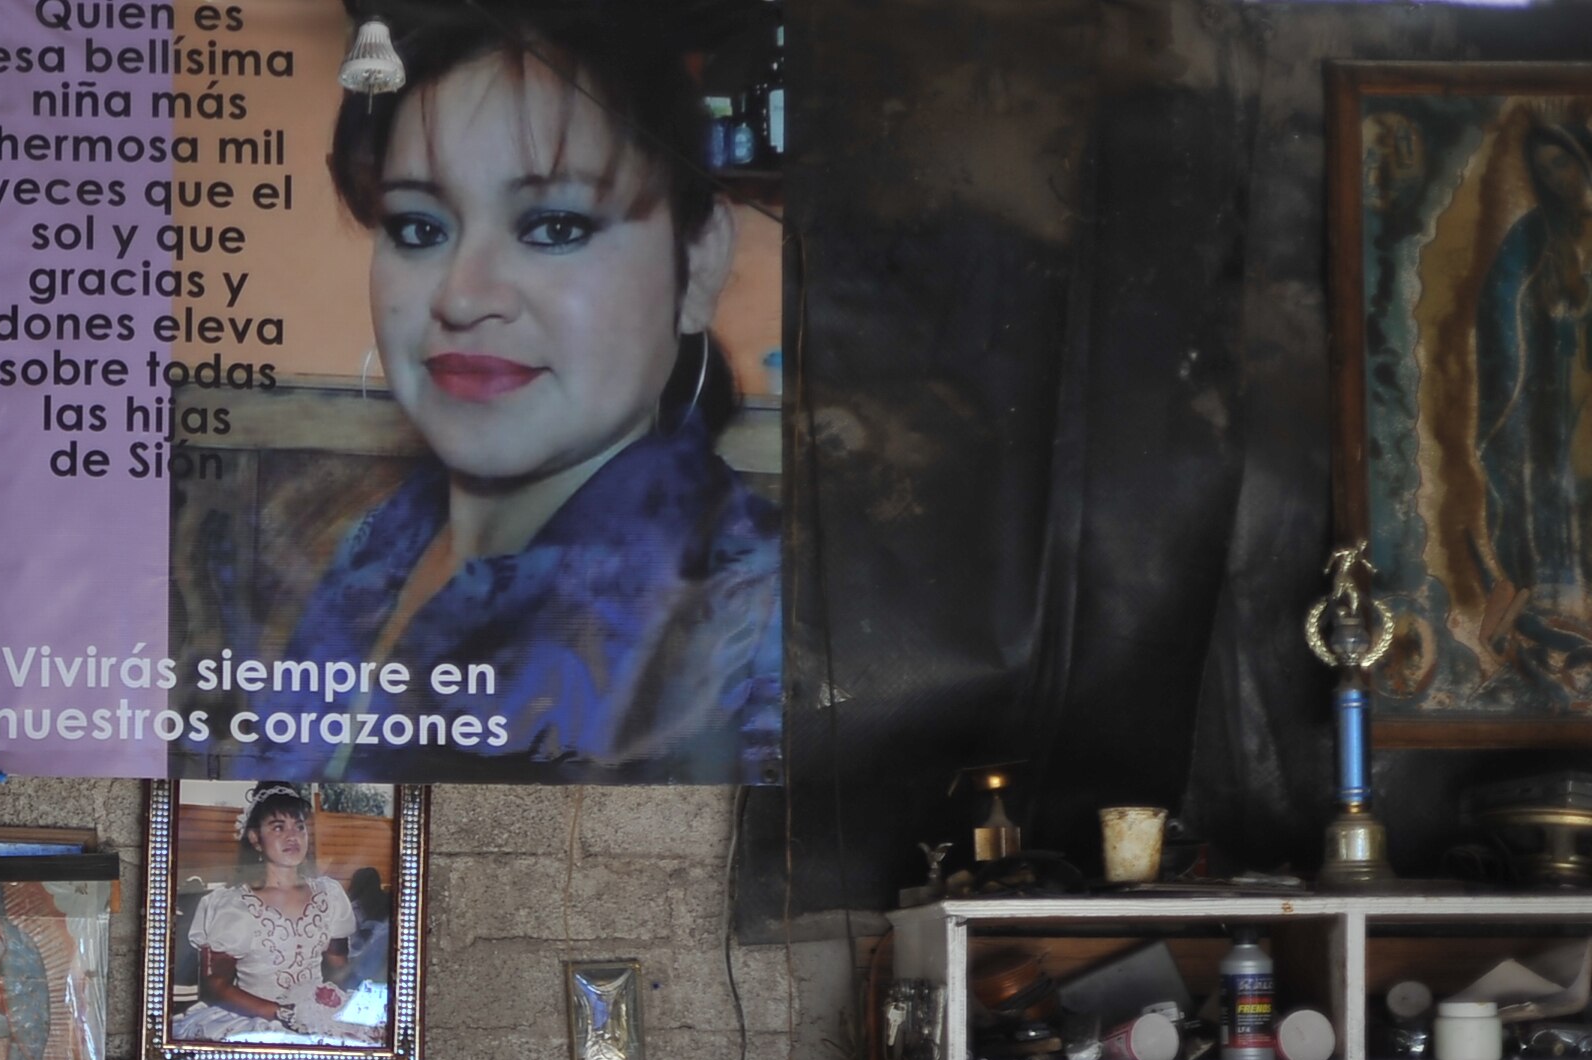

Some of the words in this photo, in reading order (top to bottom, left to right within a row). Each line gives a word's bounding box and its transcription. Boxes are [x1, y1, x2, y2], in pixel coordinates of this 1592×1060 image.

[194, 3, 244, 32] es
[86, 36, 294, 77] bellísima
[33, 81, 131, 118] niña
[152, 81, 247, 120] más
[219, 129, 284, 165] mil
[144, 180, 234, 215] que
[252, 175, 292, 210] el
[32, 215, 95, 251] sol
[112, 223, 140, 259] y
[157, 224, 247, 260] que
[29, 260, 205, 304] gracias
[222, 271, 250, 308] y
[153, 307, 284, 345] eleva
[0, 350, 129, 387] sobre
[147, 351, 277, 390] todas
[43, 394, 107, 432] las
[126, 395, 231, 442] hijas
[49, 440, 110, 478] de
[128, 439, 223, 480] Sión
[2, 642, 177, 690] Vivirás
[196, 648, 410, 702] siempre
[431, 662, 496, 695] en
[230, 709, 508, 747] corazones
